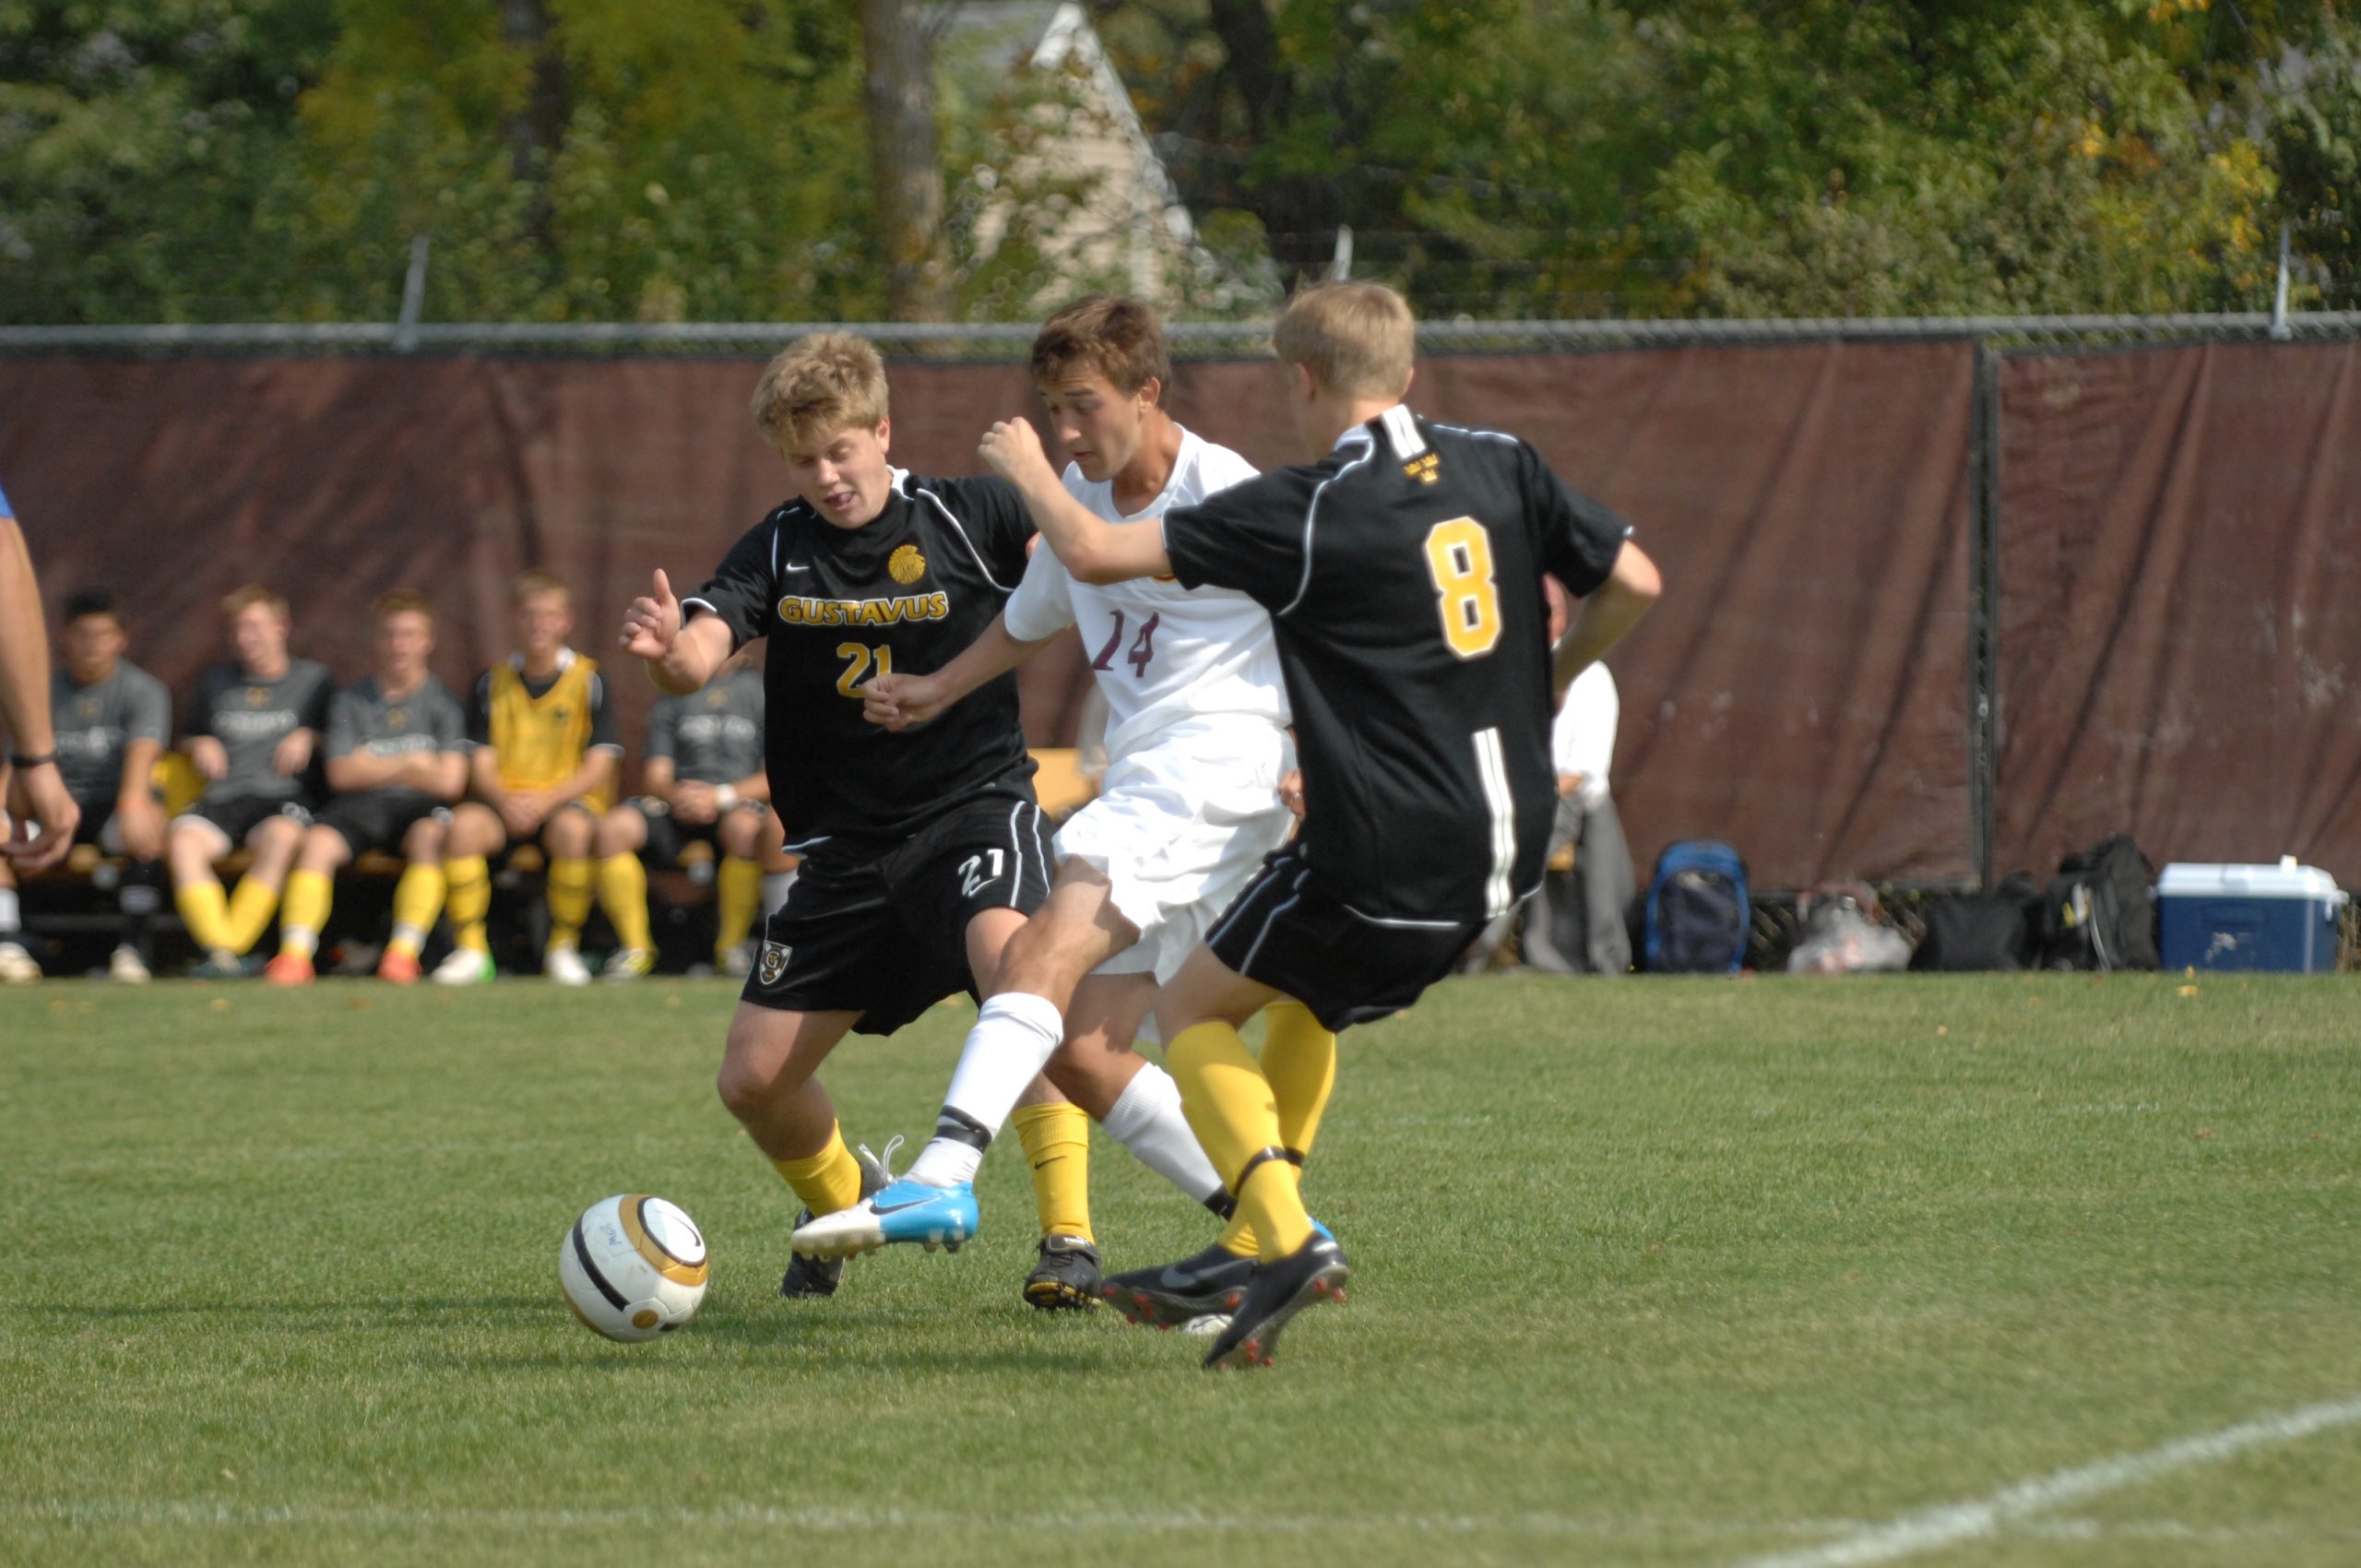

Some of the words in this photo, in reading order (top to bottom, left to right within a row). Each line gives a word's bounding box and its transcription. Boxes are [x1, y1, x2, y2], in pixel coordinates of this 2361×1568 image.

[777, 590, 950, 626] GUSTAVUS
[1424, 515, 1503, 660] 8
[836, 642, 892, 699] 21
[1092, 609, 1160, 678] 14
[957, 849, 1004, 897] 21
